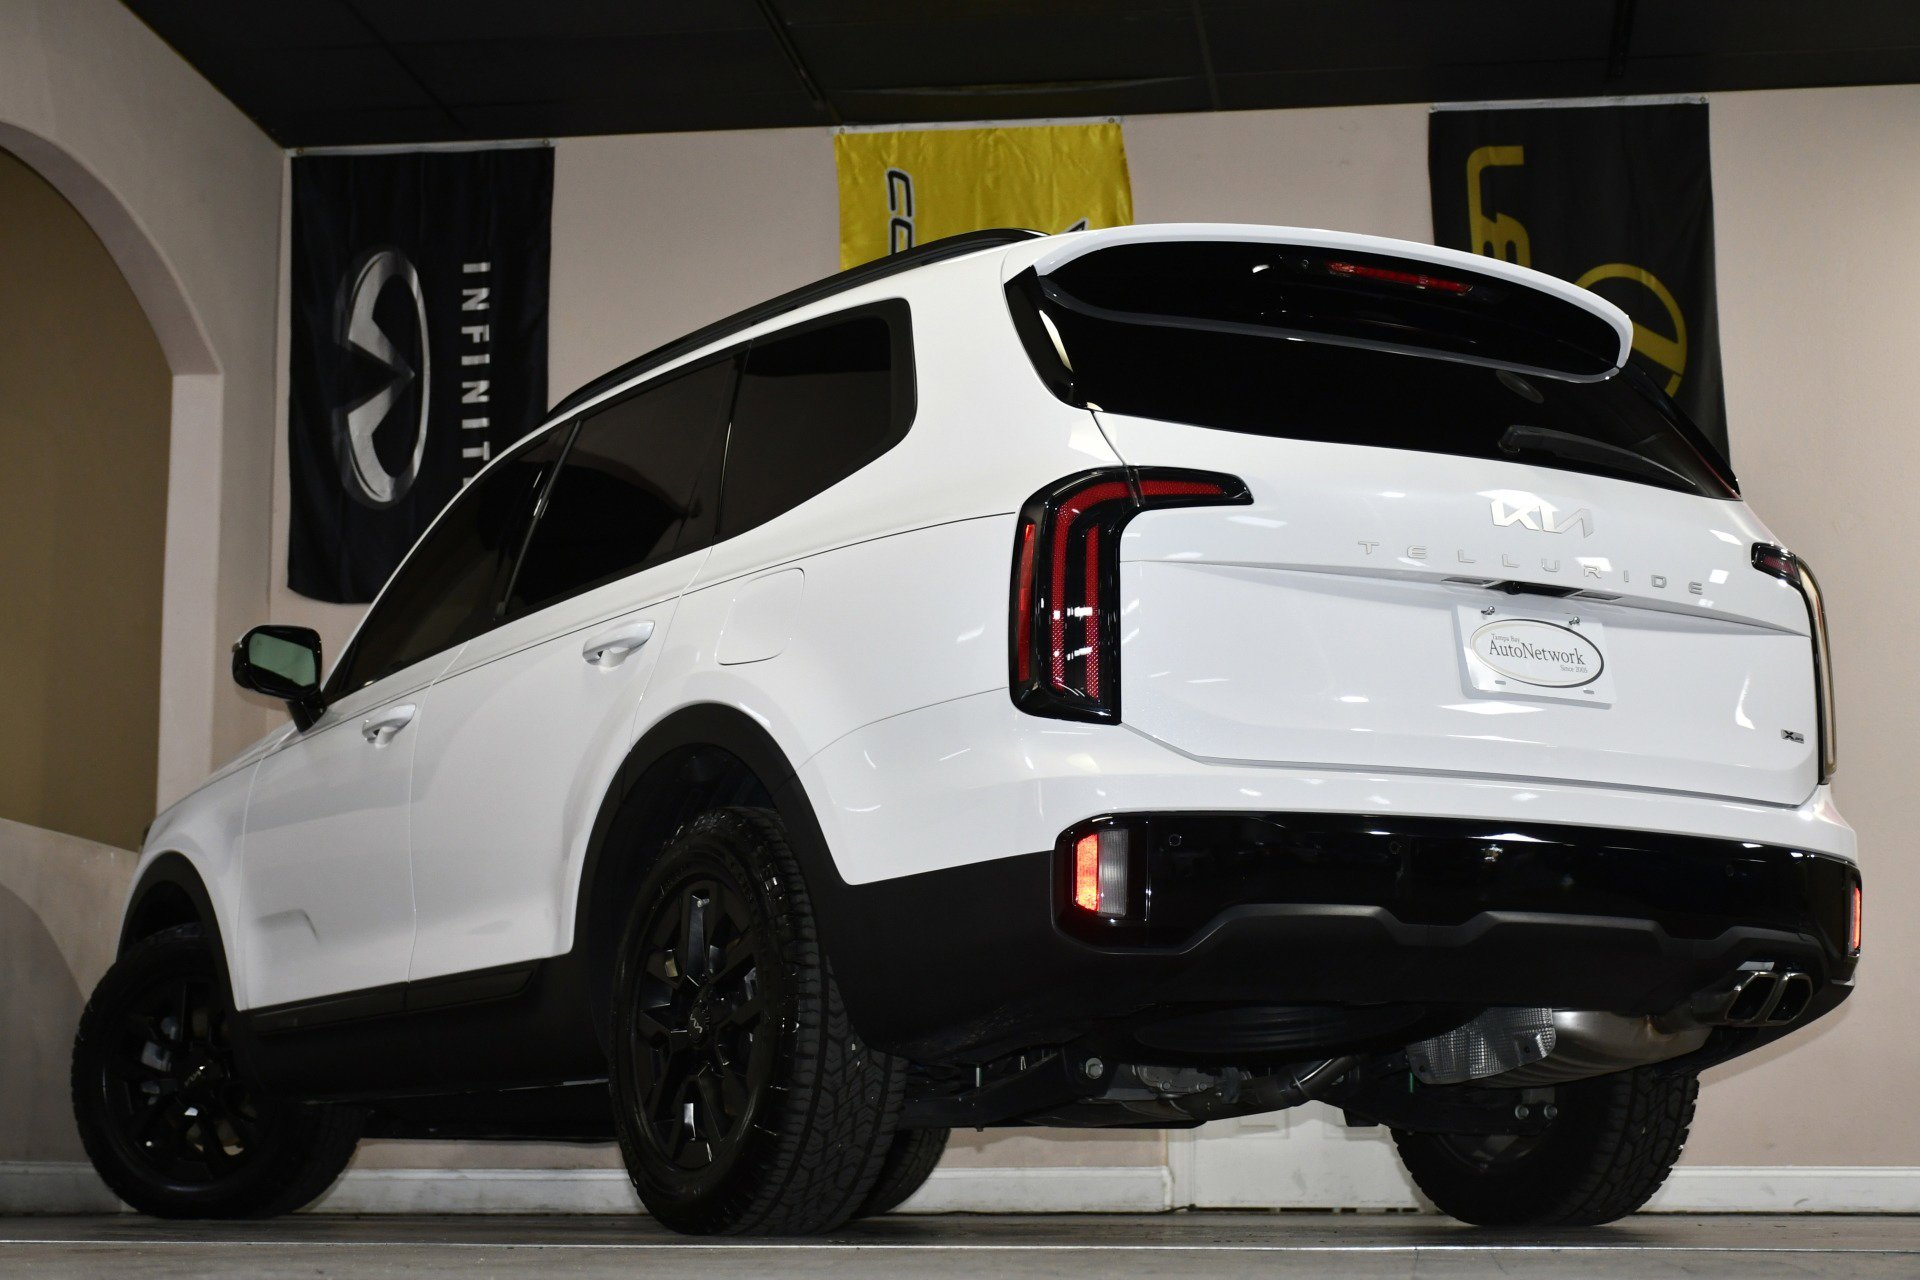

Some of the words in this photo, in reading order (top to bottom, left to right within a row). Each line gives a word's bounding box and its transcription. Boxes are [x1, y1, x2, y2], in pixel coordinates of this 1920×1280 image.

[1490, 500, 1594, 538] KIA
[1358, 541, 1704, 595] TELLURIDE
[1489, 640, 1585, 665] AutoNetwork
[1492, 633, 1510, 642] Tampa
[1511, 635, 1520, 643] Bay
